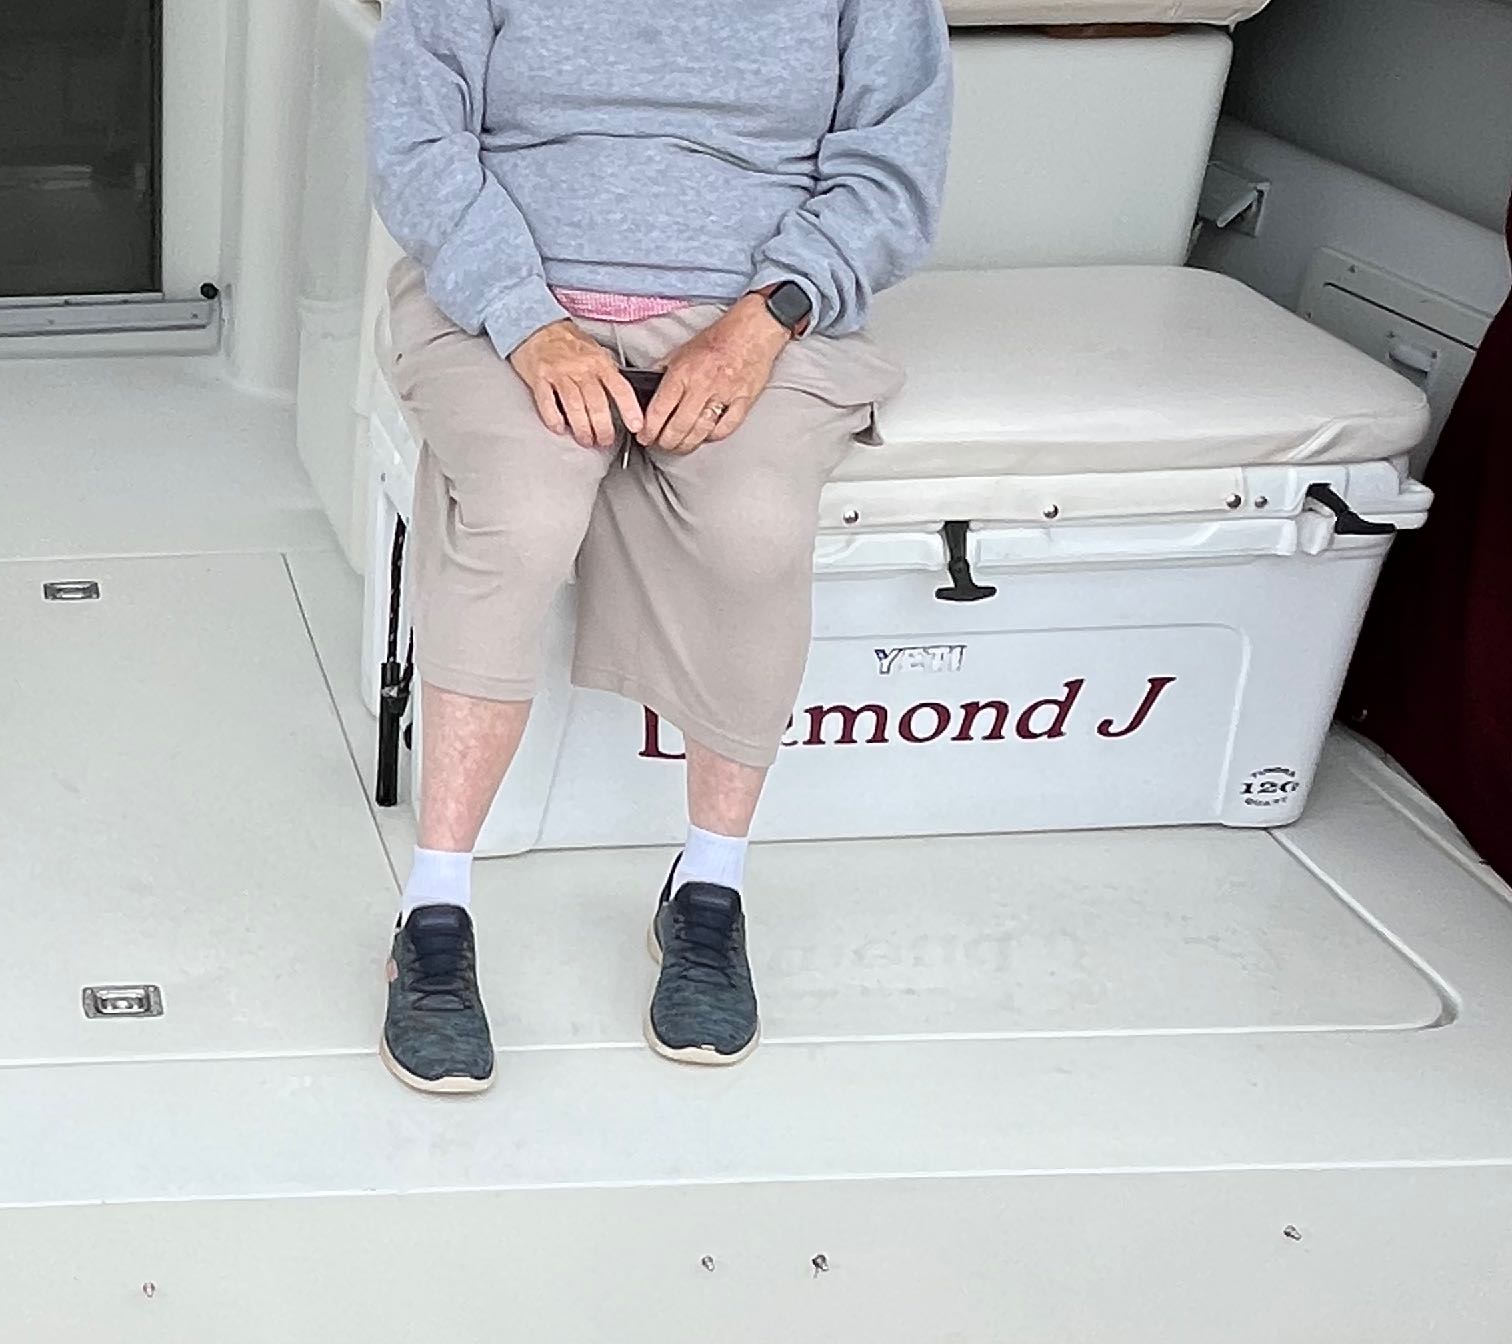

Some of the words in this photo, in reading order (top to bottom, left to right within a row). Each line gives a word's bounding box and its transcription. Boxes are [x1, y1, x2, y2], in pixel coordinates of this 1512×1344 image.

[874, 644, 968, 675] YETI
[638, 678, 1086, 760] mond
[1096, 676, 1178, 739] J
